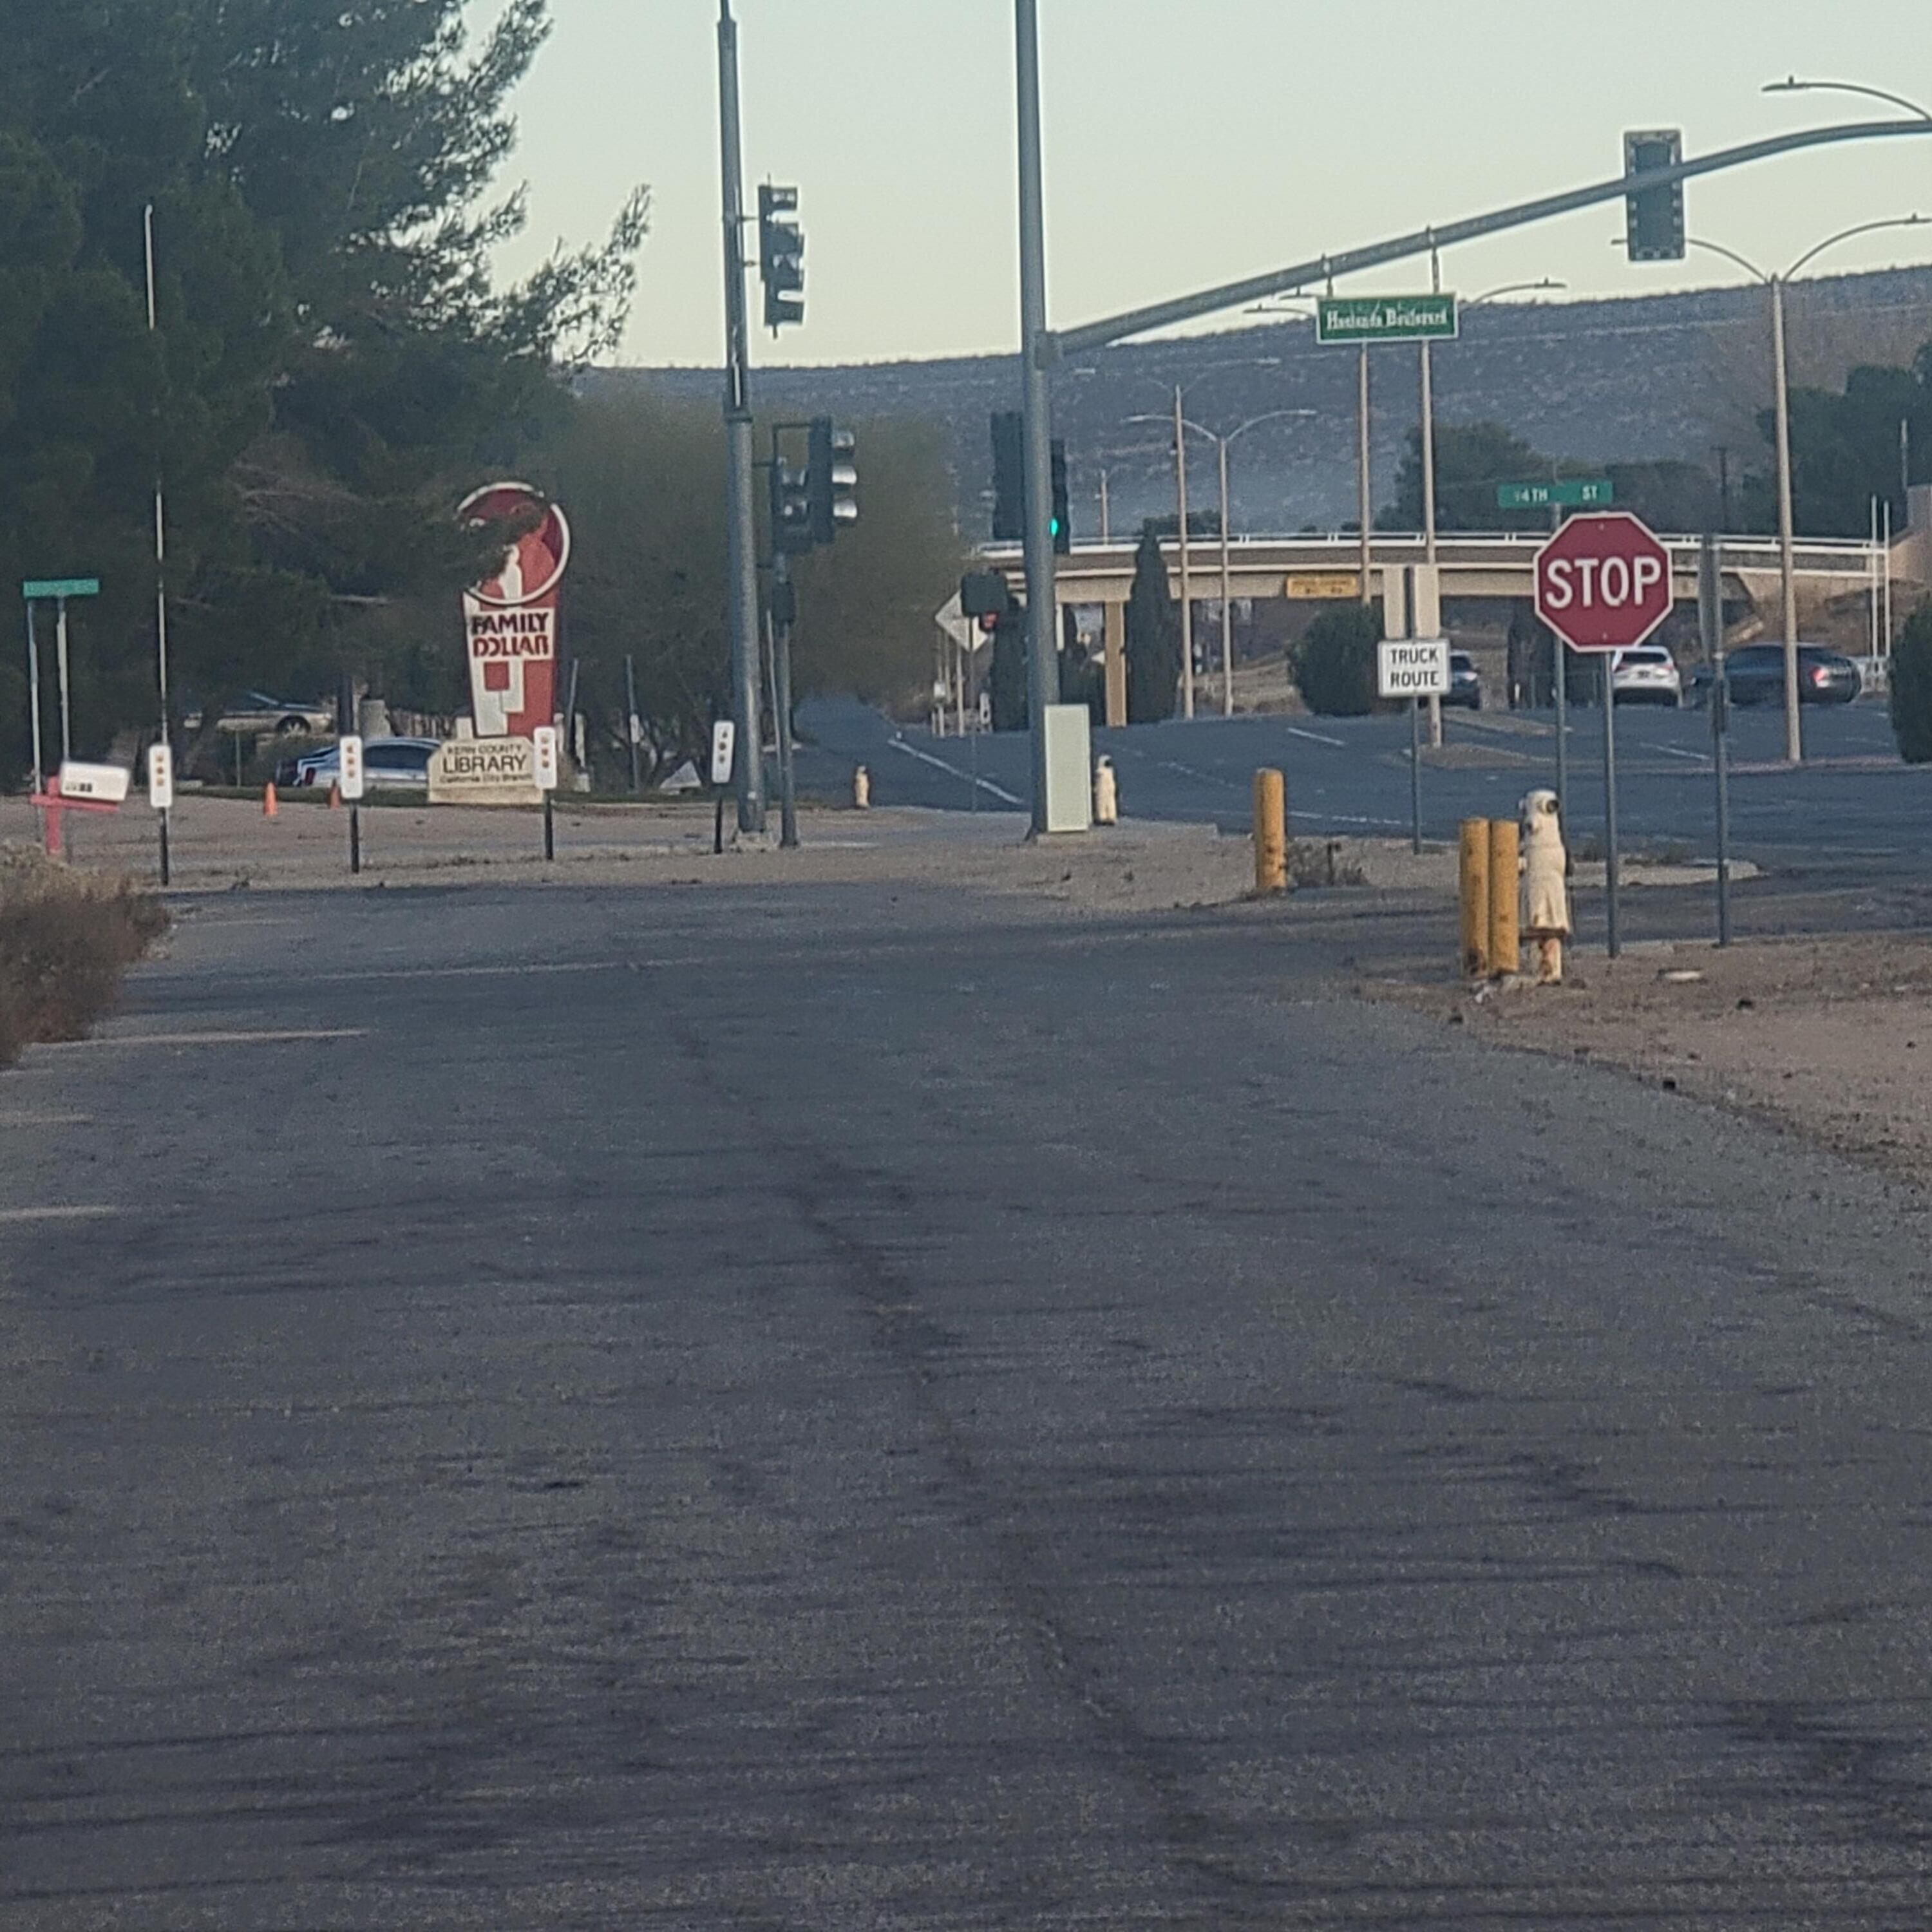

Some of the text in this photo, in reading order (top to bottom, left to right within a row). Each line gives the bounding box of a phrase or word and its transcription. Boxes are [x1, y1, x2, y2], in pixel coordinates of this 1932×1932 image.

[1582, 485, 1598, 501] ST
[1546, 556, 1661, 609] STOP
[471, 612, 549, 635] FAMILY
[1390, 648, 1438, 665] TRUCK
[1390, 670, 1439, 688] ROUTE
[442, 754, 526, 773] LIBRARY
